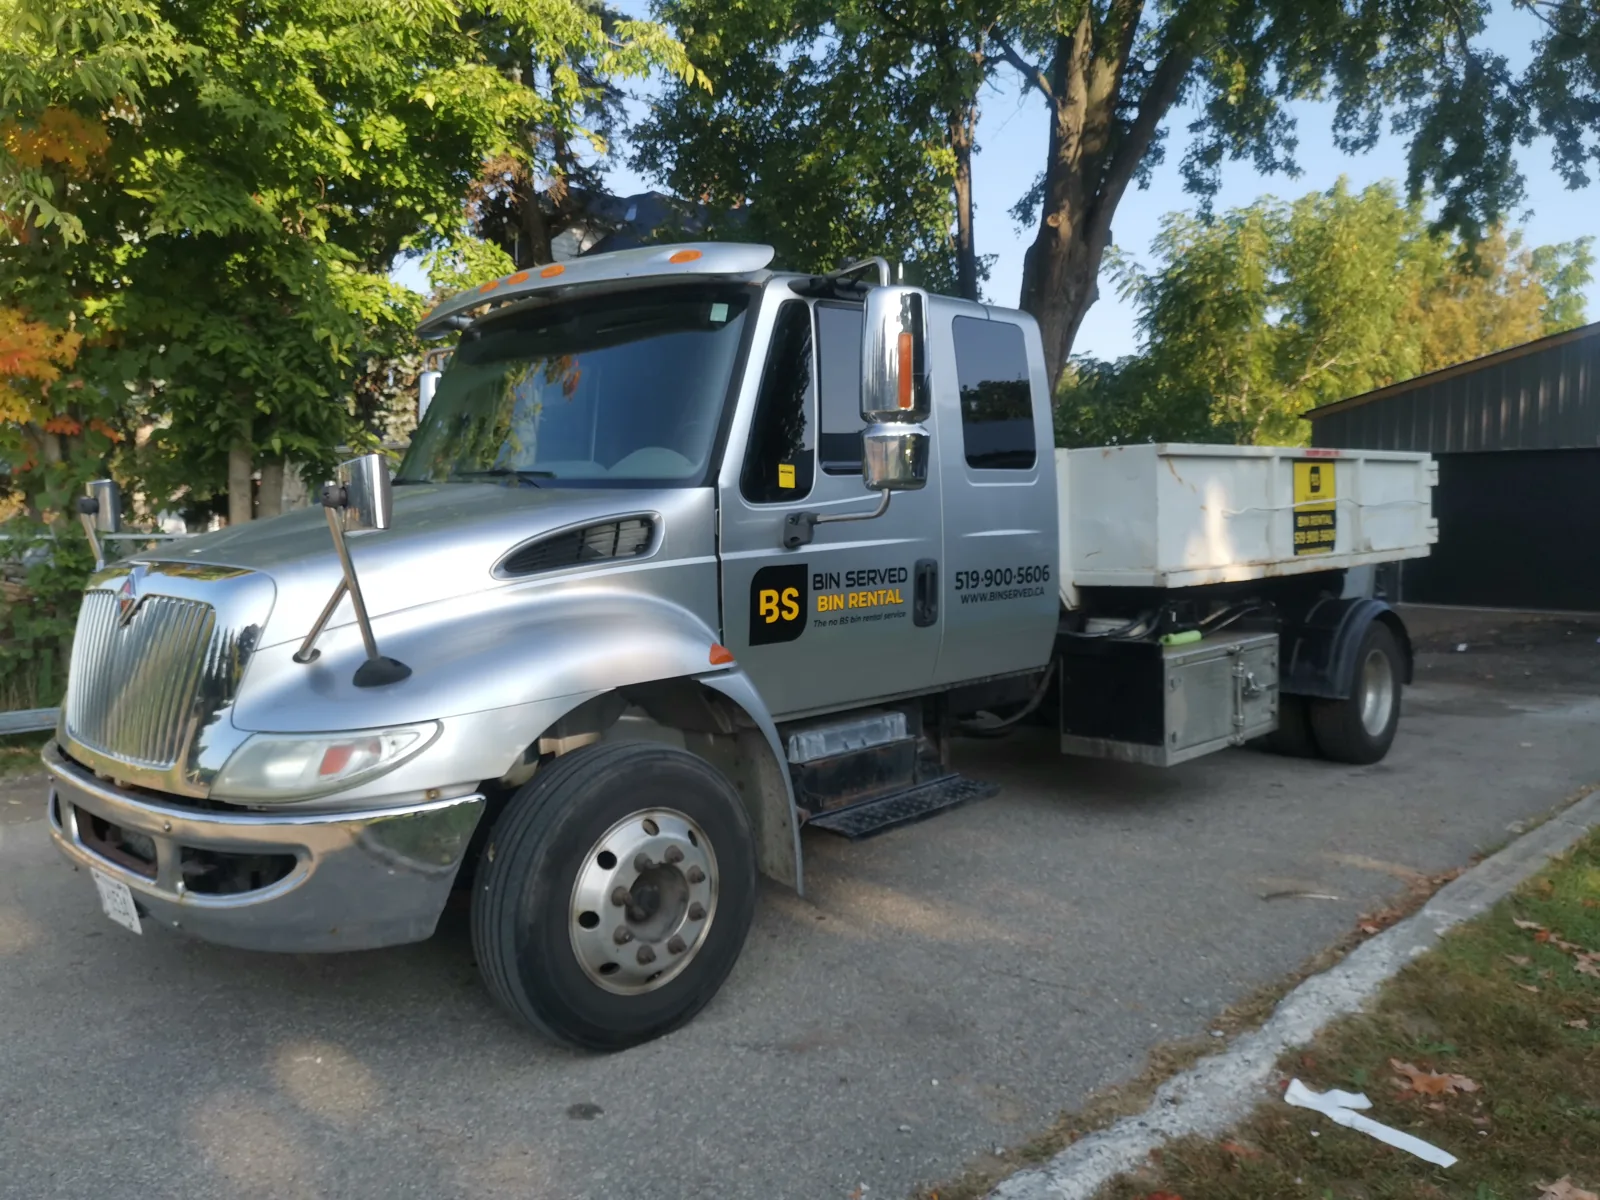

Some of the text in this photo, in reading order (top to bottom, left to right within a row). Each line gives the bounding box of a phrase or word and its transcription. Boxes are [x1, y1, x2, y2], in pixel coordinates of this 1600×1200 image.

[812, 567, 908, 591] BIN SERVED
[759, 587, 800, 624] BS
[817, 588, 904, 612] BIN RENTAL
[960, 586, 1045, 604] WWW.BINSERVED.CA
[813, 610, 906, 628] The no BS bin rental service
